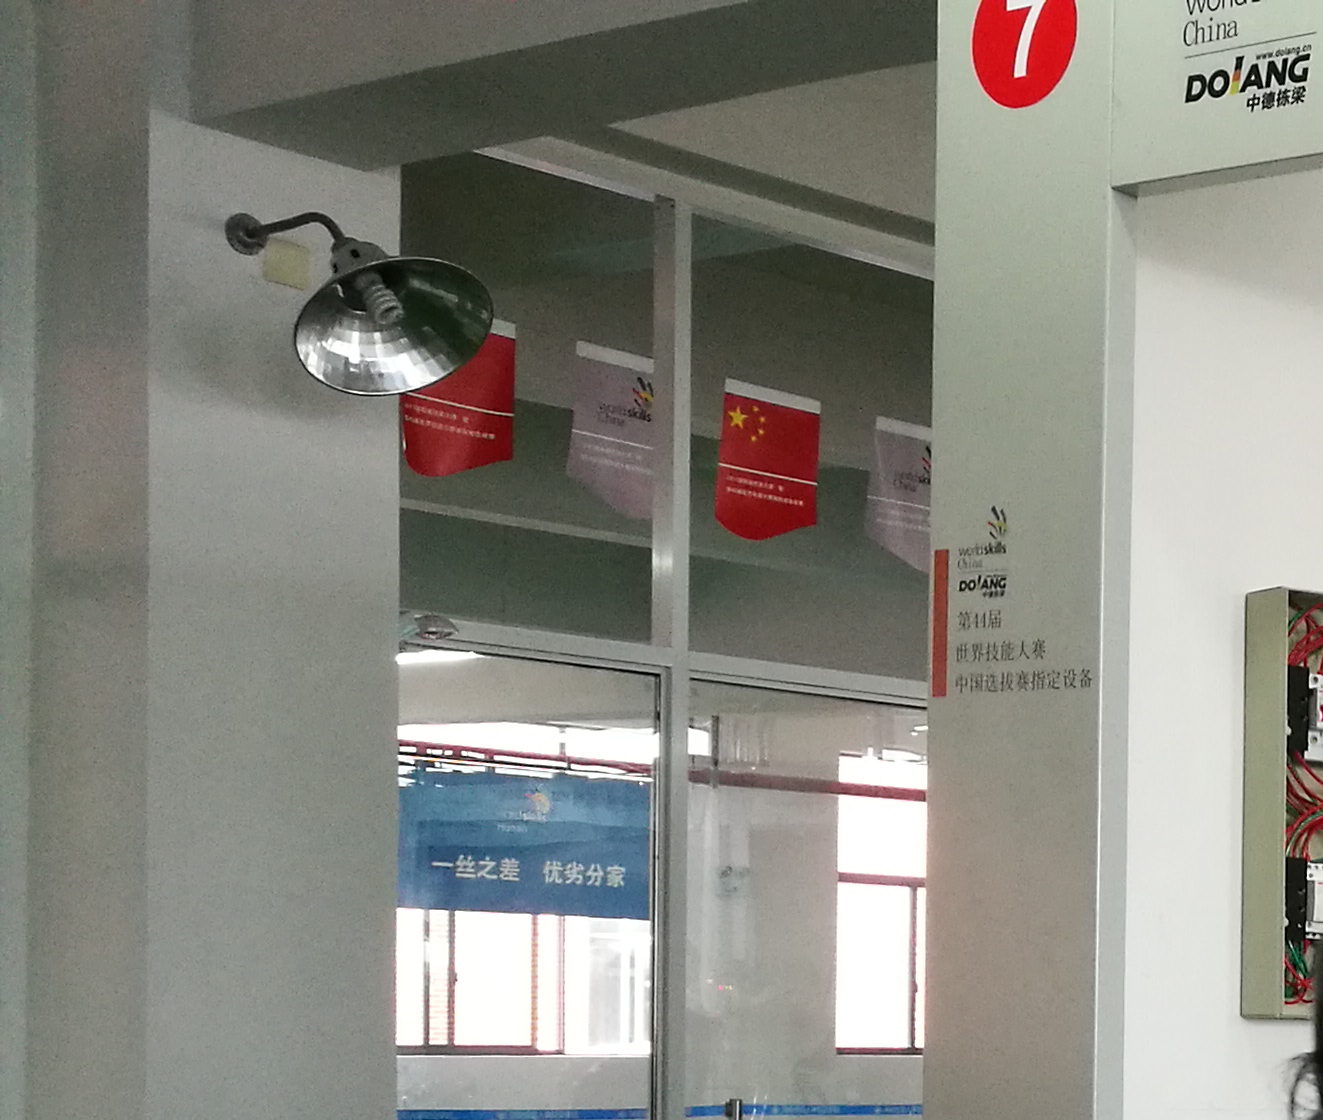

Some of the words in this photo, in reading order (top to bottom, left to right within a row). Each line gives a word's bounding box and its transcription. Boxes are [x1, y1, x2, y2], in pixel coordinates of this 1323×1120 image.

[1004, 0, 1041, 78] 7
[1183, 17, 1238, 46] China
[1256, 44, 1312, 60] www.dolang.cn
[956, 638, 1046, 663] 世界技能大赛
[955, 667, 1093, 695] 中国选拔赛指定设备
[431, 854, 520, 882] 一丝之差
[542, 859, 627, 888] 优劣分家
